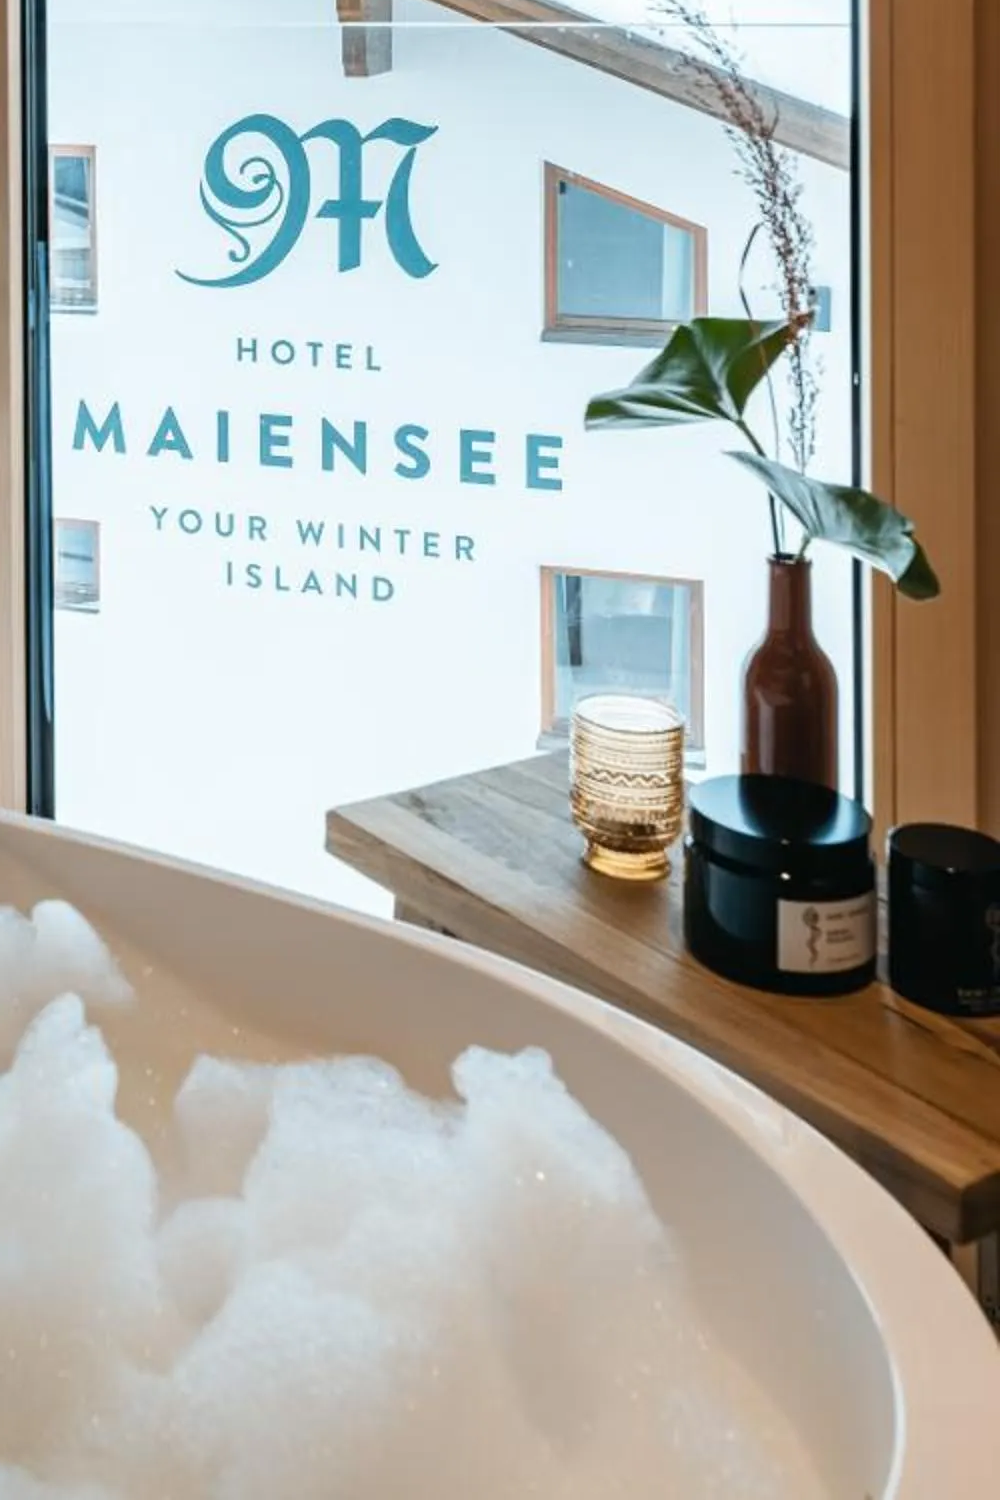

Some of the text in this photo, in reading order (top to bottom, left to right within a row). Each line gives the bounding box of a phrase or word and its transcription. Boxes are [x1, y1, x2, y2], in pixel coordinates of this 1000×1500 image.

[236, 337, 382, 372] HOTEL
[71, 398, 563, 491] MAIENSEE
[149, 506, 476, 562] YOUR WINTER
[226, 560, 395, 603] ISLAND
